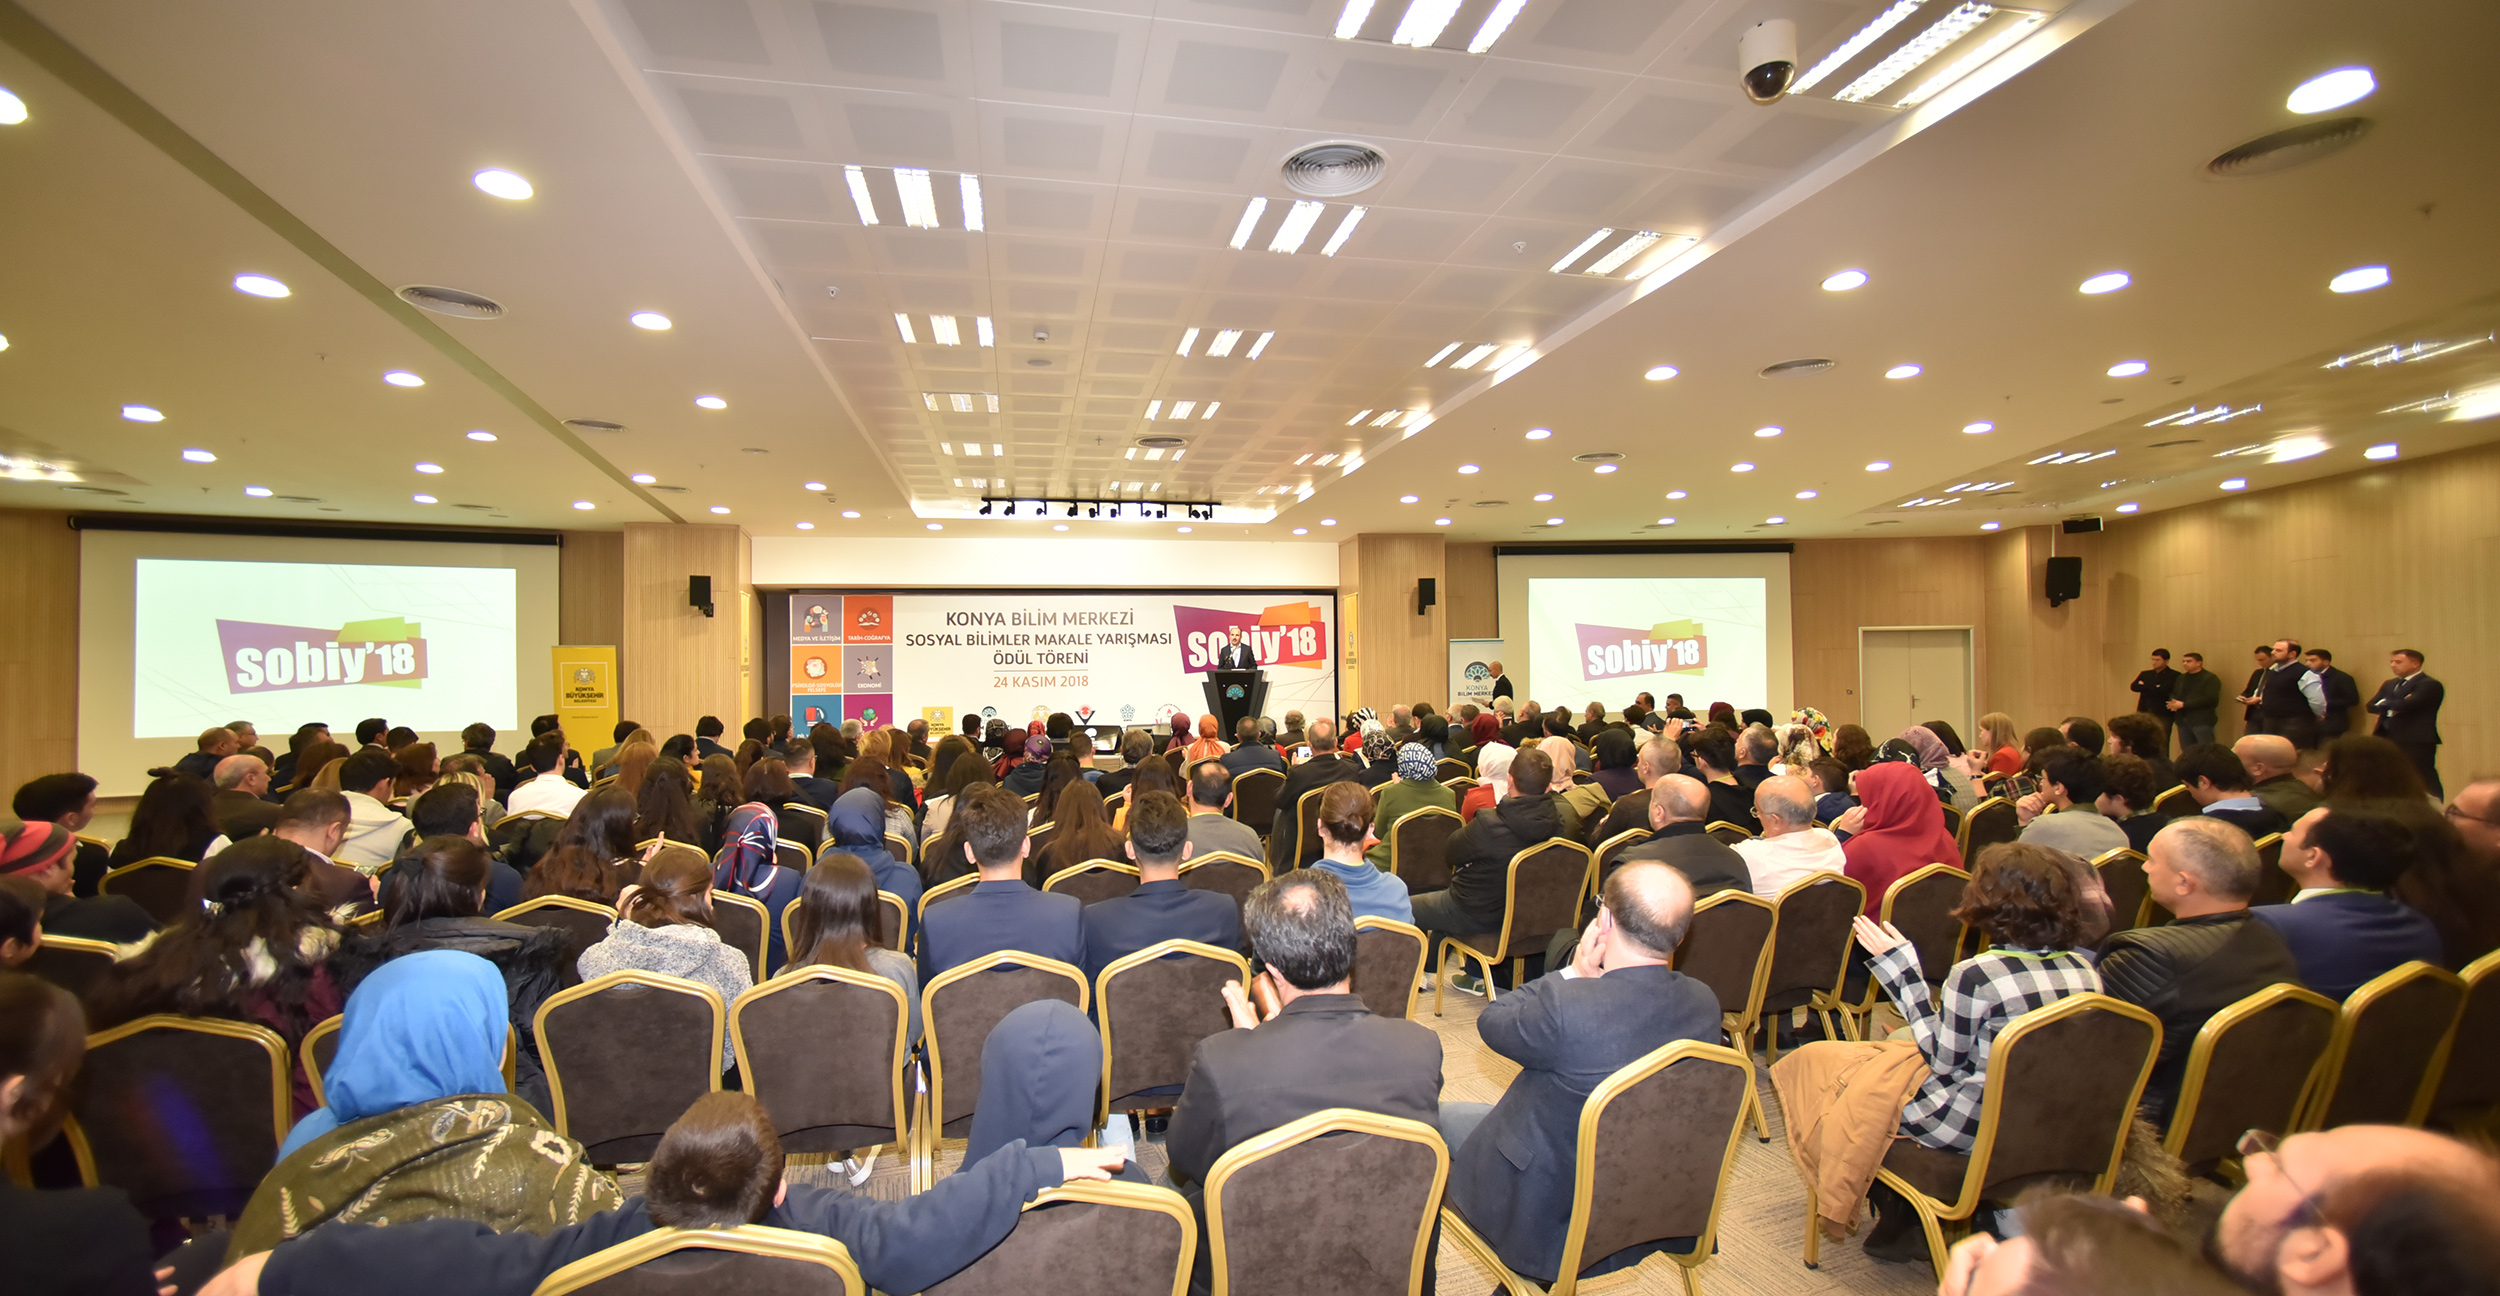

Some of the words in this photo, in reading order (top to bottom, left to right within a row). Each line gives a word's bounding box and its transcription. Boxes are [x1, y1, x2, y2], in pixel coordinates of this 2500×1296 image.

[946, 611, 1006, 626] KONYA
[1011, 608, 1057, 626] BİLİM
[1063, 607, 1134, 626] MERKEZİ
[905, 633, 962, 647] SOSYAL
[966, 630, 1031, 646] BİLİMLER
[1034, 633, 1093, 646] MAKALE
[1096, 632, 1172, 648] YARIŞMASI
[235, 641, 416, 688] sobiy'18
[993, 649, 1033, 665] ÖDÜL
[1036, 648, 1089, 665] TÖRENİ
[1586, 638, 1700, 676] sobiy'18
[993, 676, 1009, 688] 24
[1012, 676, 1056, 688] KASIM
[1060, 675, 1089, 687] 2018
